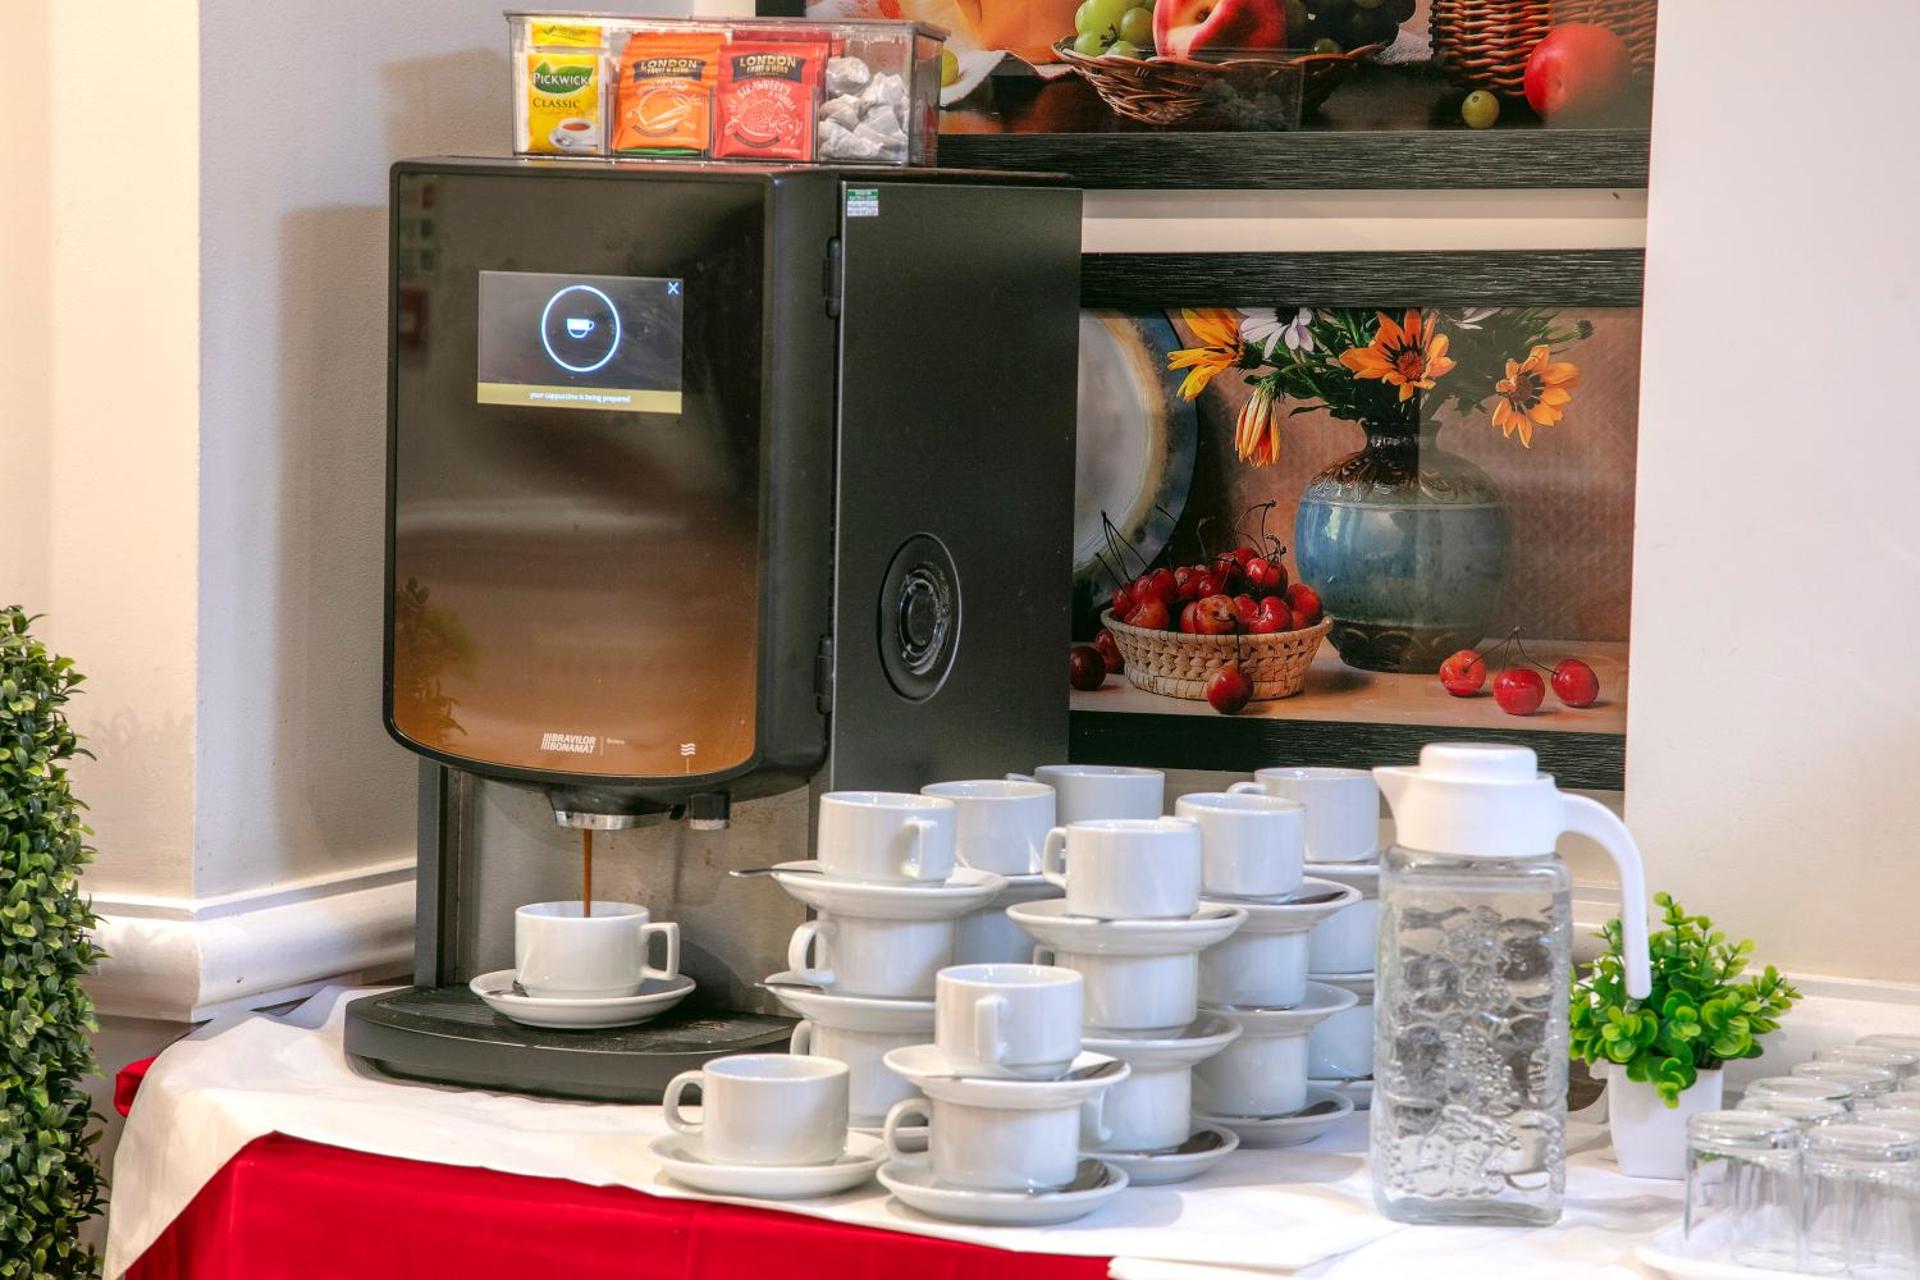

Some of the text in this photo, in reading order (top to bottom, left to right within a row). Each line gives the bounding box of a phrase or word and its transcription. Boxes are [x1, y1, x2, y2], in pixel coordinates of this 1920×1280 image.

[640, 59, 697, 70] LONDON
[739, 55, 796, 68] LONDON
[533, 72, 588, 86] PICKWICK
[533, 97, 581, 108] CLASSIC
[552, 733, 596, 745] BRAVILOR
[550, 742, 595, 754] BONAMAT
